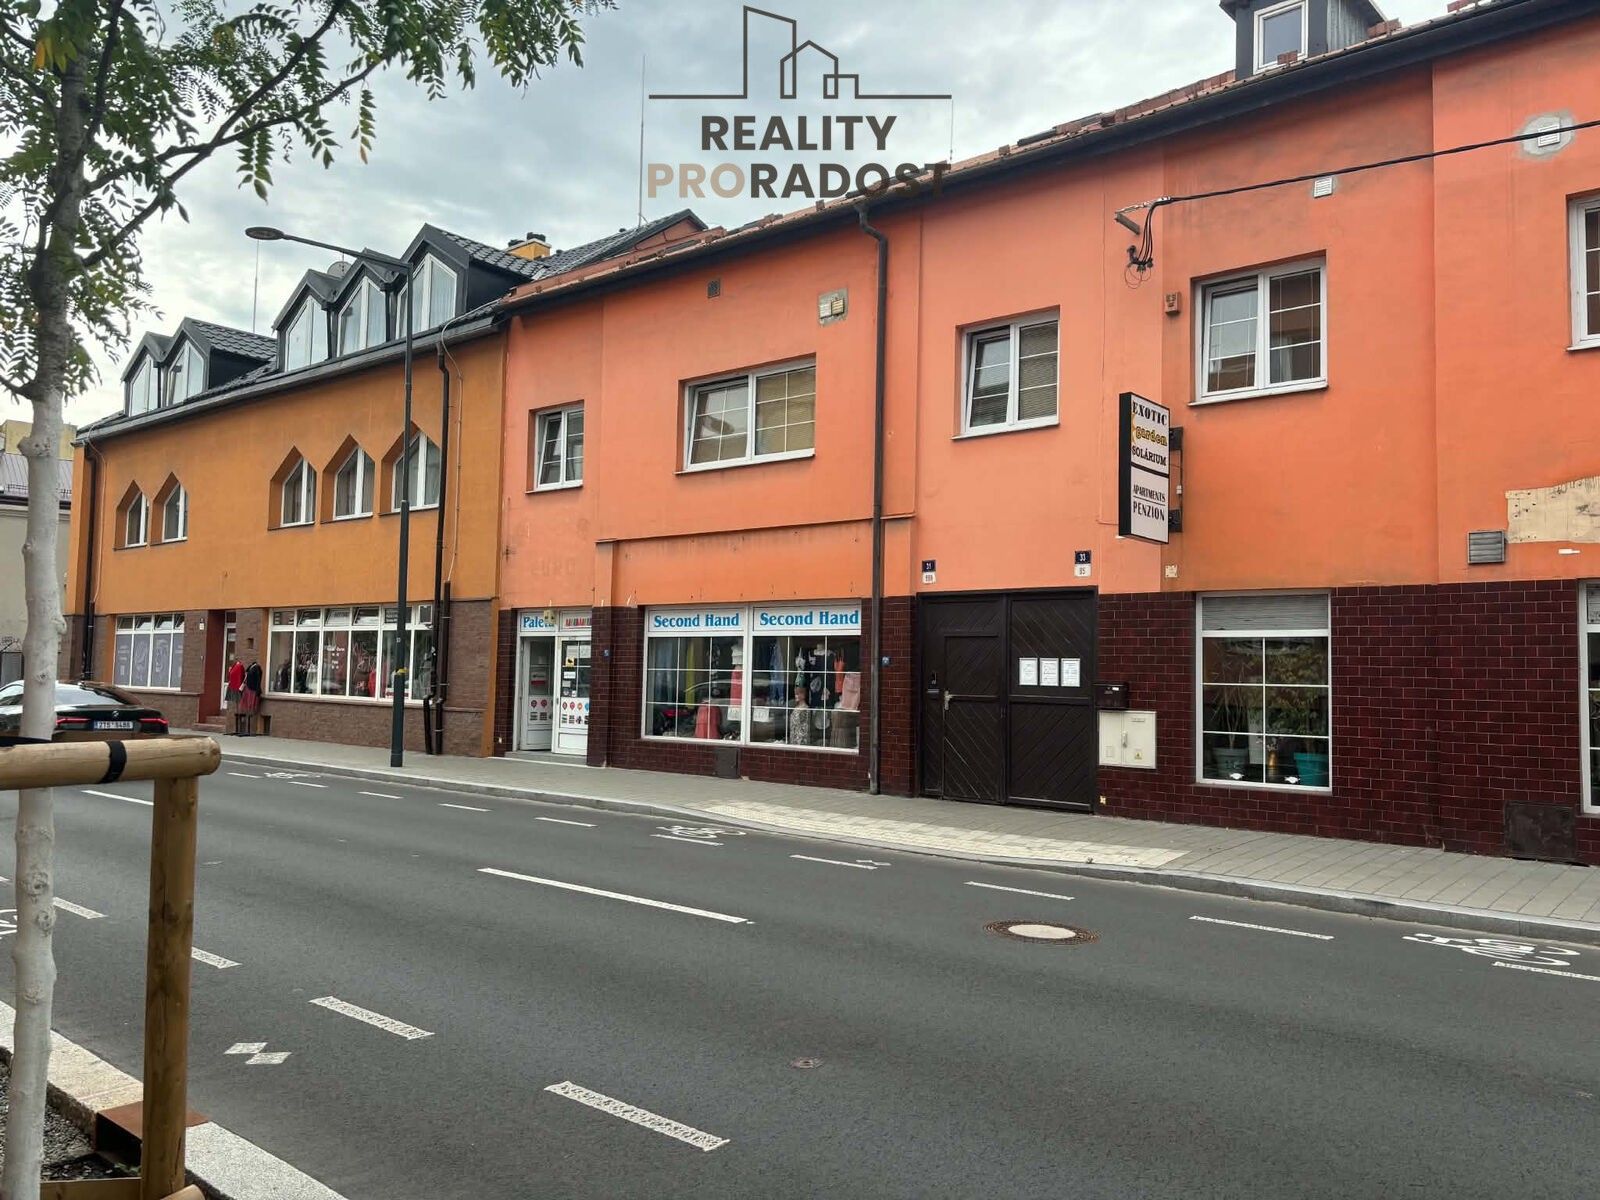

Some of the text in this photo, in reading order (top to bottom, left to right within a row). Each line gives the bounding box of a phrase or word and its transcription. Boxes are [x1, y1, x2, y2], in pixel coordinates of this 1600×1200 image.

[1132, 401, 1167, 426] EXOTIC
[1135, 426, 1167, 447] garden
[1131, 445, 1167, 467] SOLÁRIUM
[1133, 483, 1166, 503] APARTMENTS
[1133, 501, 1165, 521] PENZION
[653, 612, 740, 628] Second Hand
[759, 609, 859, 626] Second Hand
